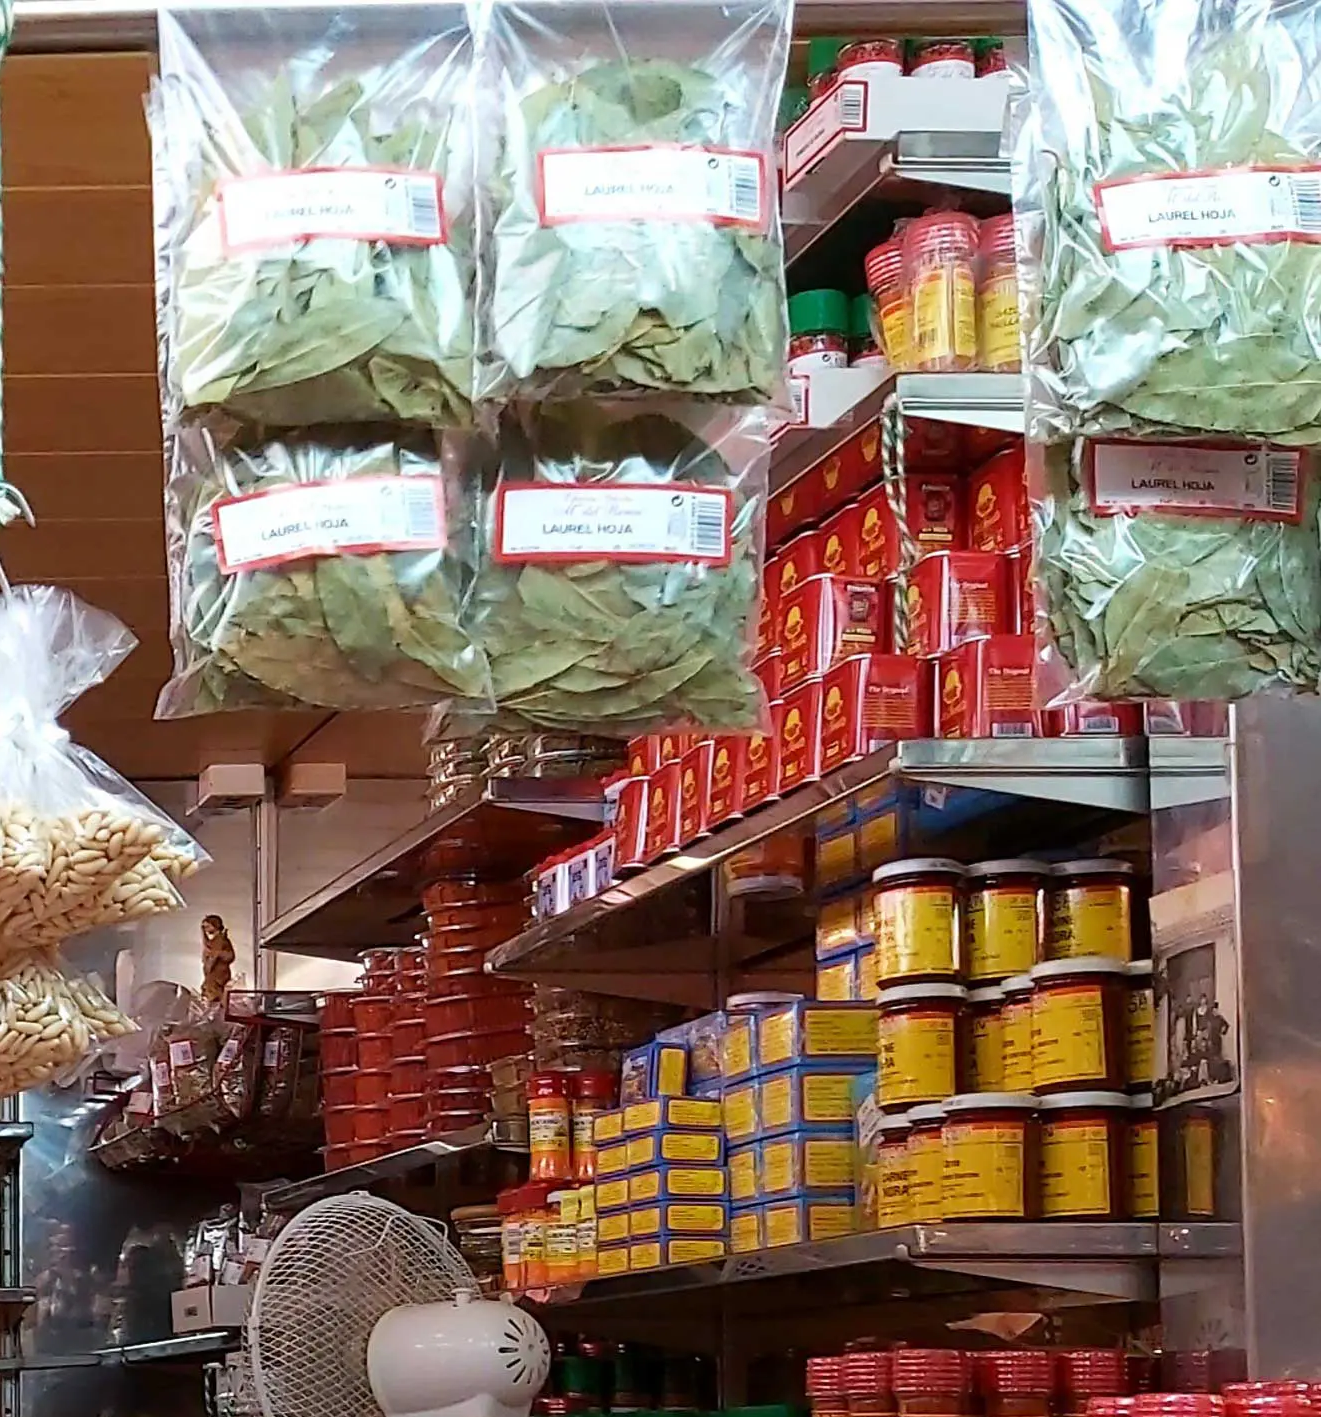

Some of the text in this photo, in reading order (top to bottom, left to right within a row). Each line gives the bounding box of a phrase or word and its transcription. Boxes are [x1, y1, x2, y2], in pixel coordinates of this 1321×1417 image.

[1148, 207, 1236, 223] LAUREL HOJA
[261, 517, 349, 541] LAUREL HOJA
[542, 522, 633, 536] LAUREL HOJA
